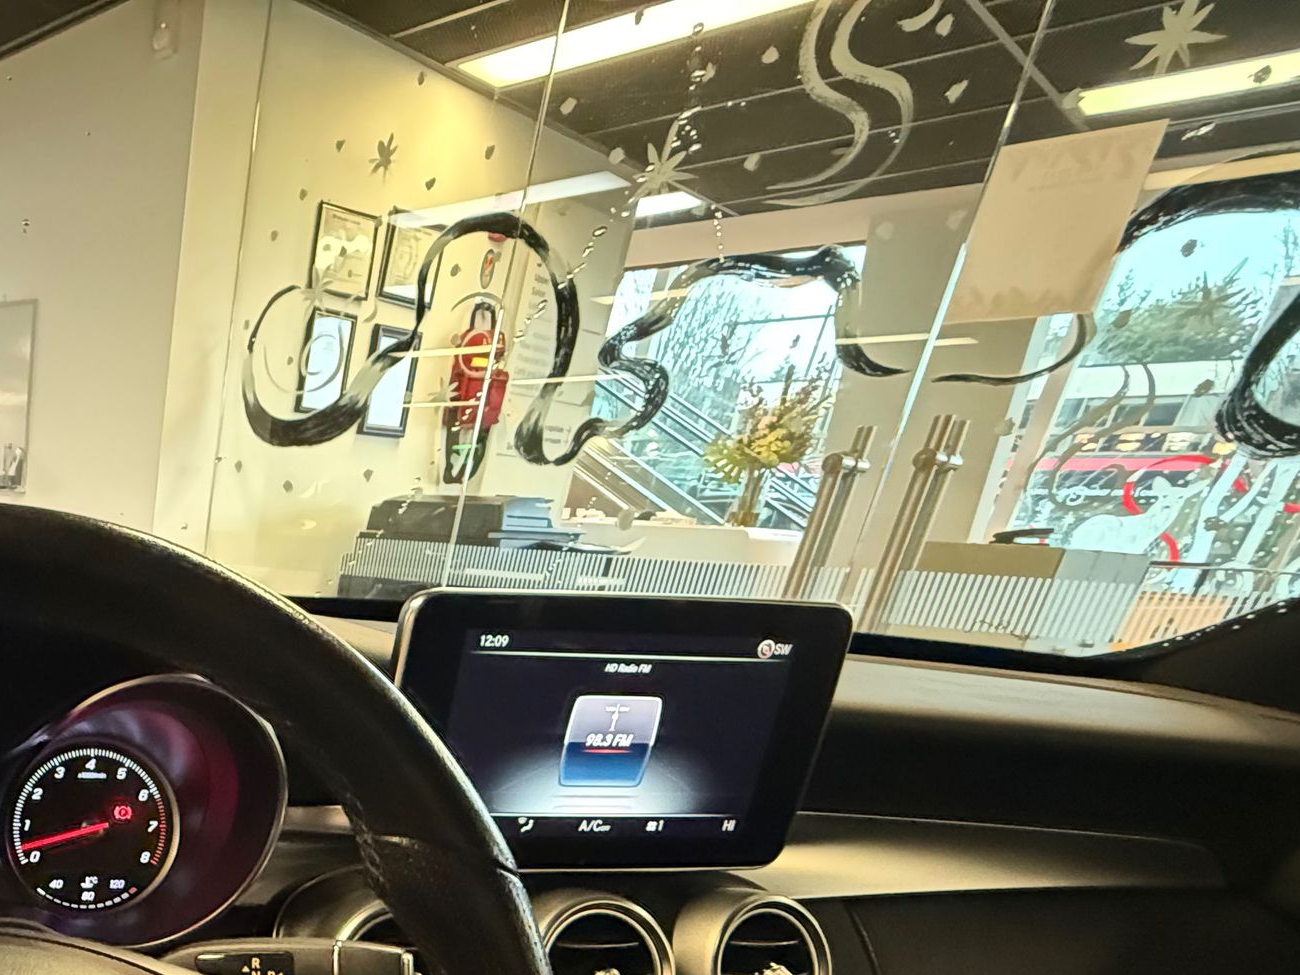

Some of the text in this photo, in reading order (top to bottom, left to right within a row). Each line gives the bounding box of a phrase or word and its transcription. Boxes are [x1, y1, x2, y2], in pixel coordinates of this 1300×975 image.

[479, 634, 509, 647] 12:09
[773, 643, 793, 656] SW
[585, 733, 634, 747] 98.3 FM
[85, 758, 97, 771] 4
[54, 766, 66, 779] 3
[116, 767, 128, 780] 5
[31, 787, 44, 800] 2
[138, 789, 150, 802] 6
[23, 819, 32, 832] 1
[147, 820, 159, 833] 7
[578, 819, 602, 832] A/C
[722, 820, 737, 832] HI
[29, 851, 41, 863] 0
[140, 851, 151, 864] 8
[49, 879, 64, 889] 40
[251, 957, 261, 969] R
